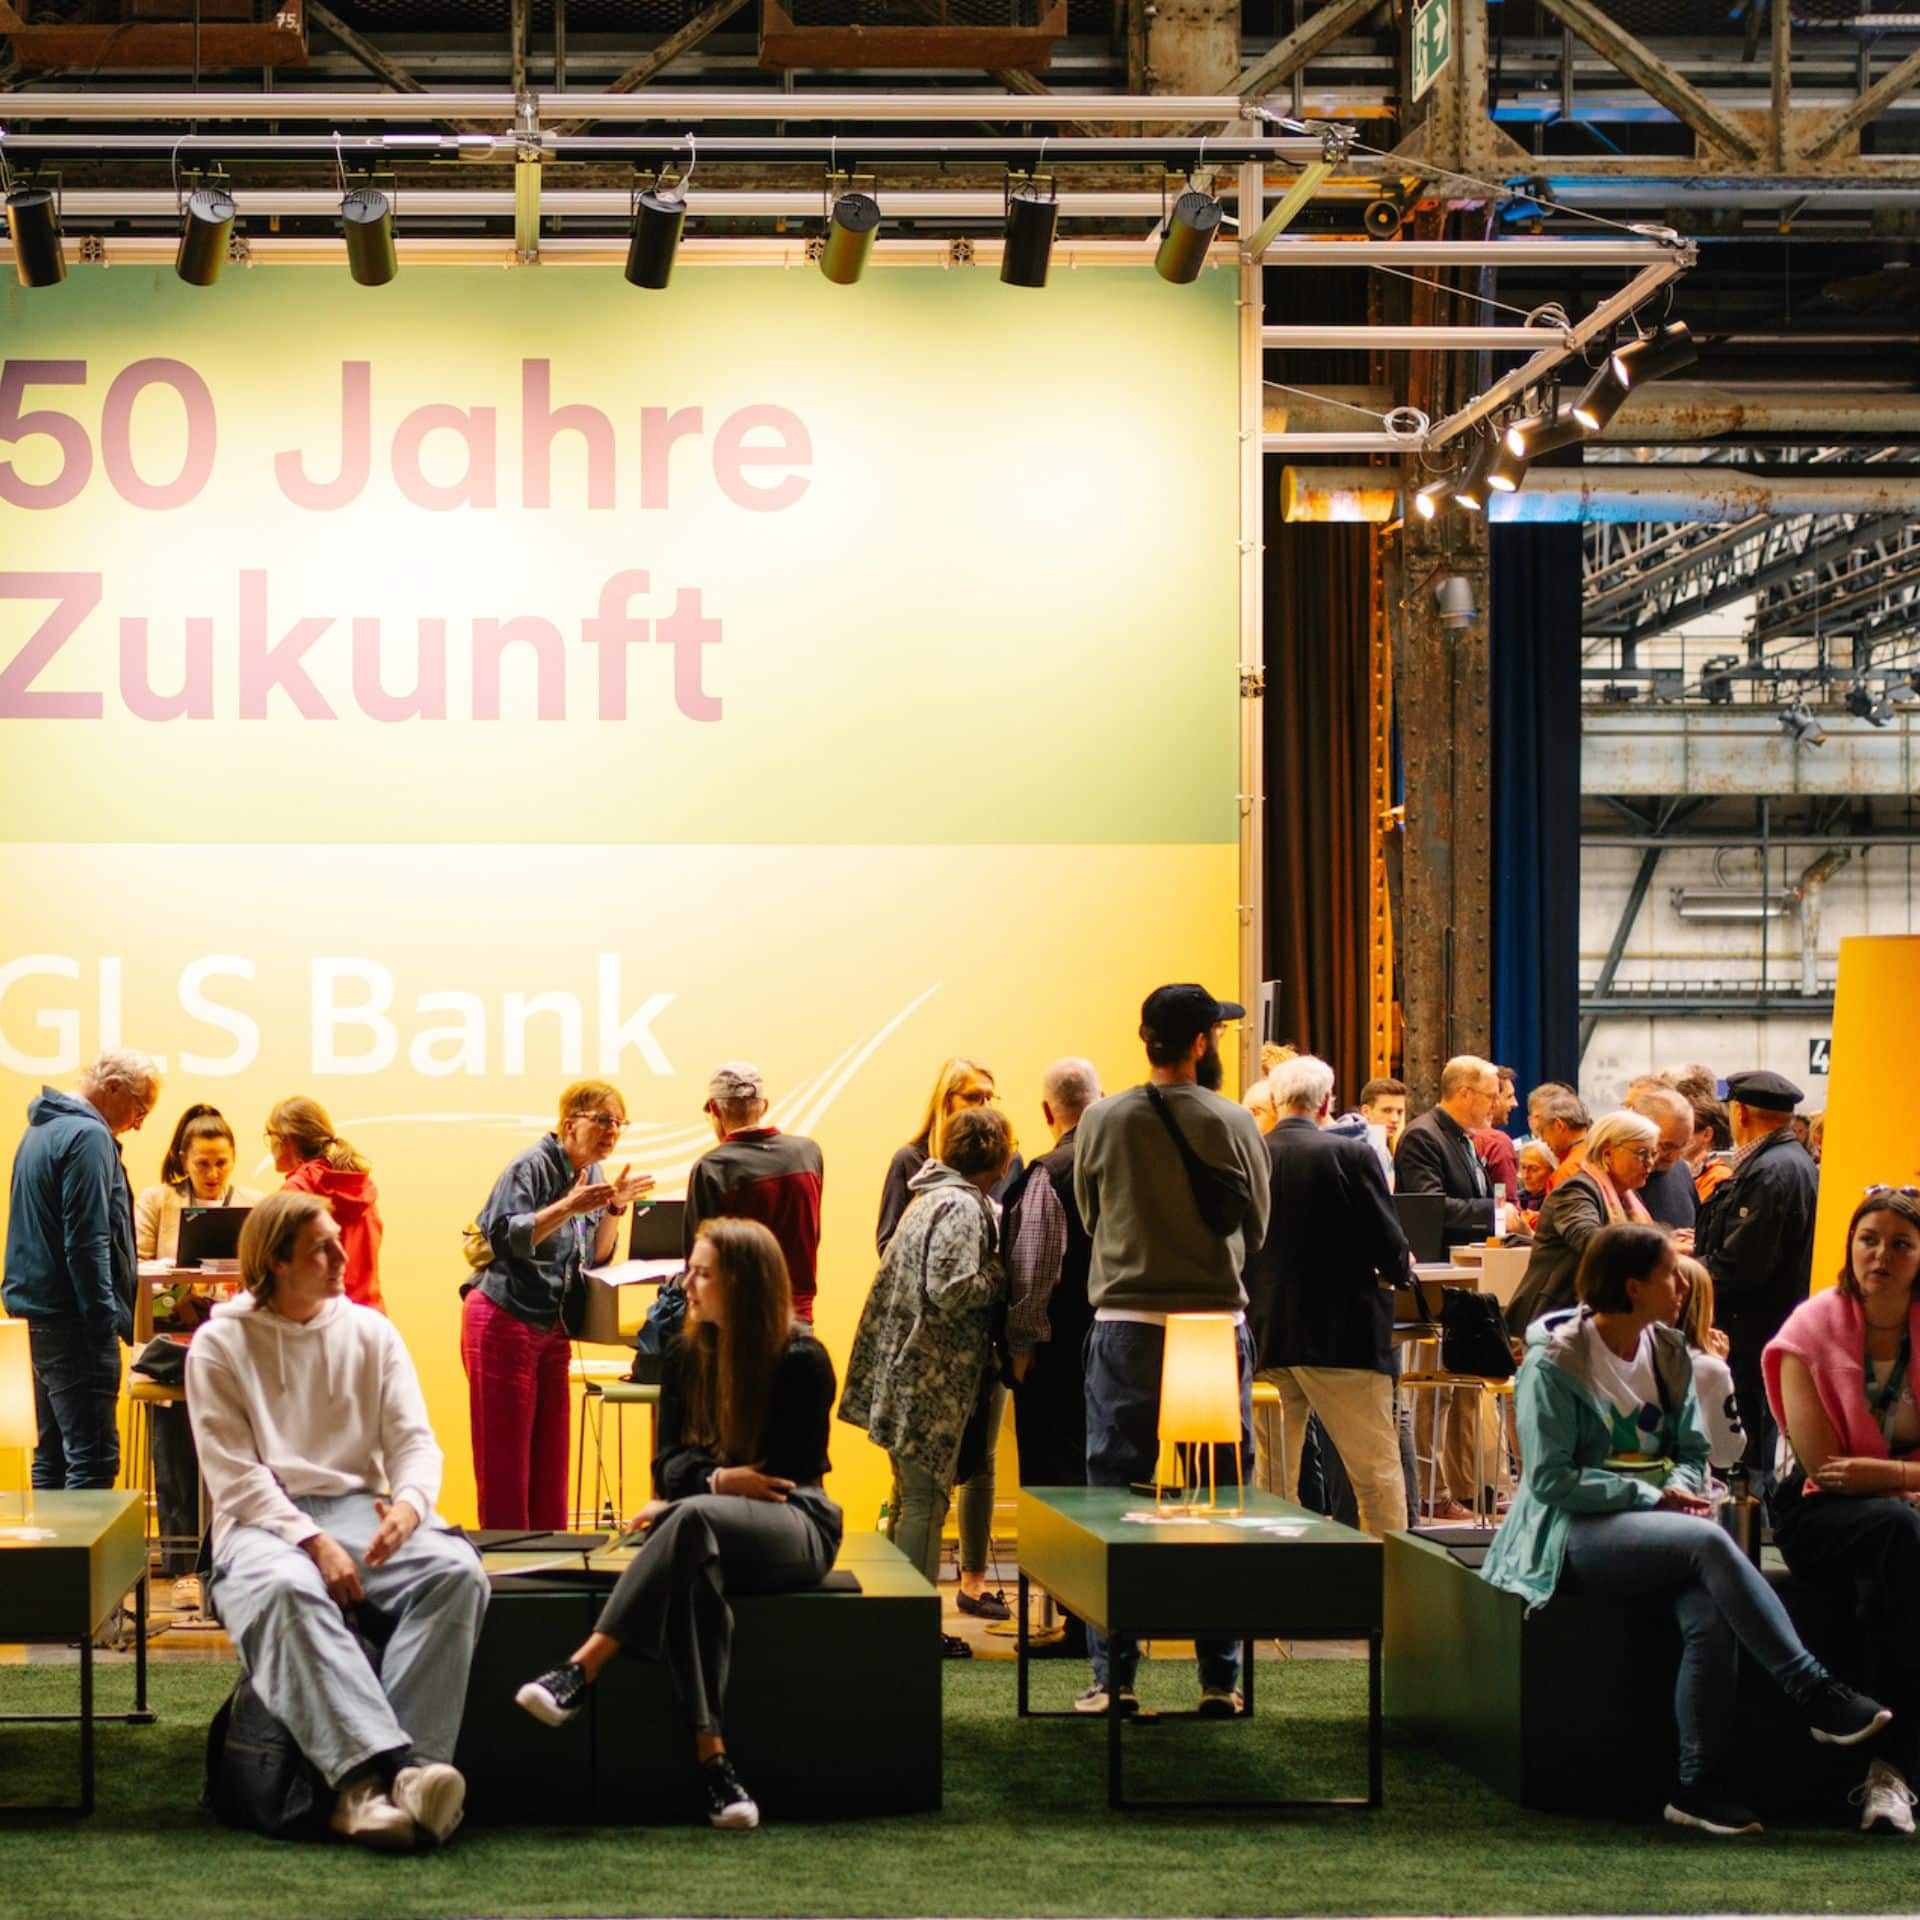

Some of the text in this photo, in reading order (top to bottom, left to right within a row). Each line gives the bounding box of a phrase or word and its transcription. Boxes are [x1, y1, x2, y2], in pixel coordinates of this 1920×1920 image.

[0, 357, 813, 512] 50 Jahre
[0, 568, 723, 722] Zukunft
[0, 951, 678, 1077] GLS Bank
[1812, 1040, 1829, 1073] 4
